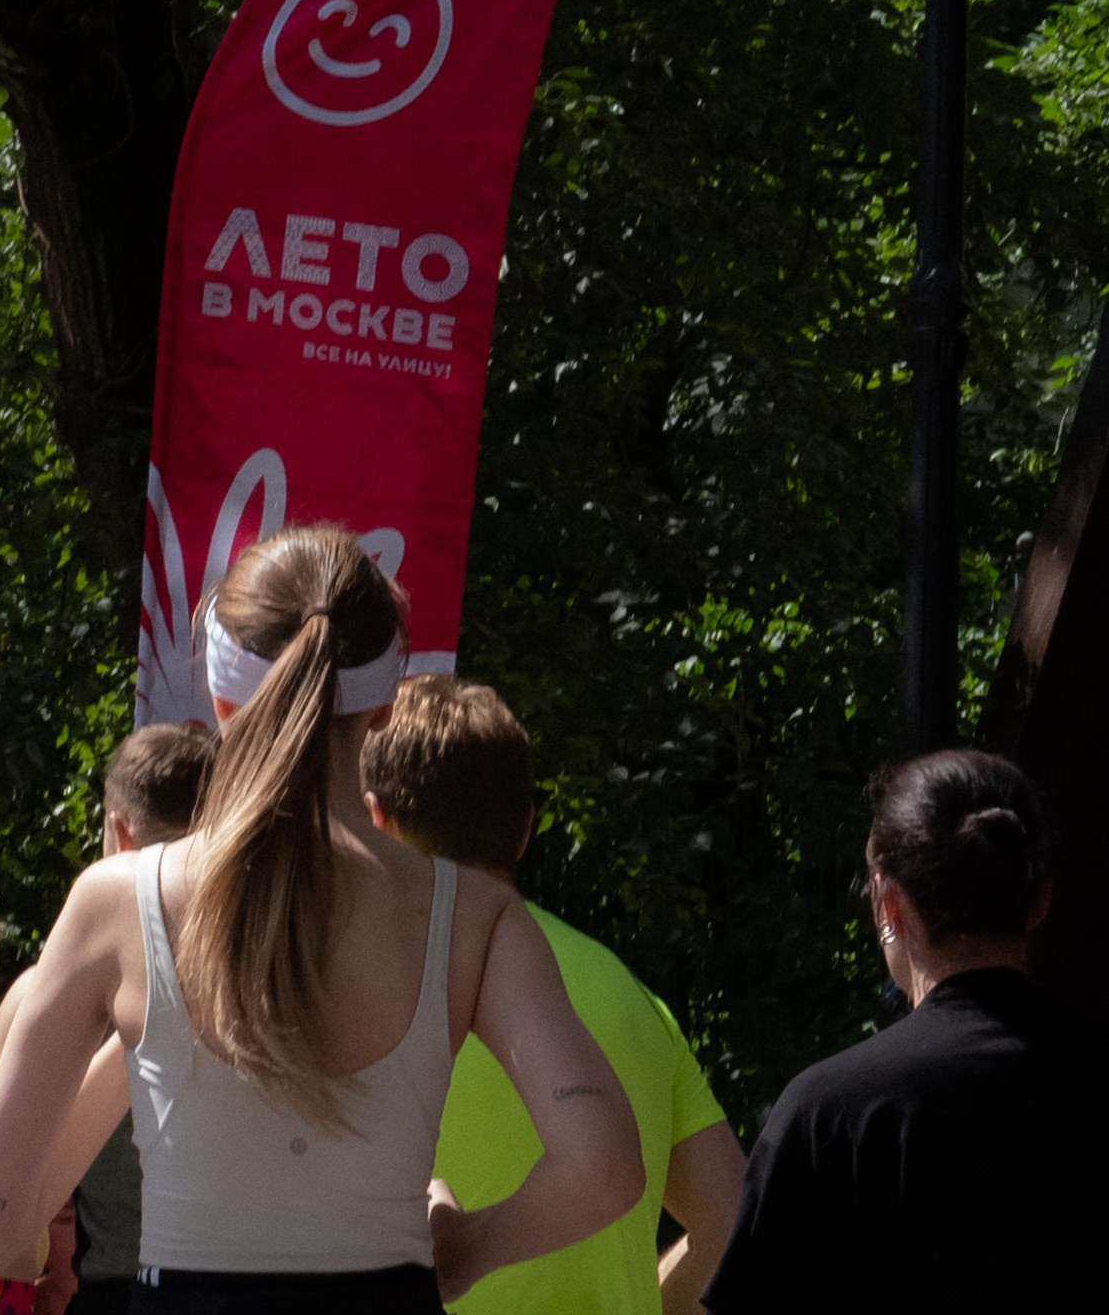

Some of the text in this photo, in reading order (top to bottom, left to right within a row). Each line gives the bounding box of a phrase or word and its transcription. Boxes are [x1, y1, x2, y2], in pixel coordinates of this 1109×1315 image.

[203, 207, 471, 303] ЛЕТО
[201, 281, 455, 350] В МОСКВЕ
[303, 342, 341, 363] ВСЕ
[345, 349, 373, 366] НА
